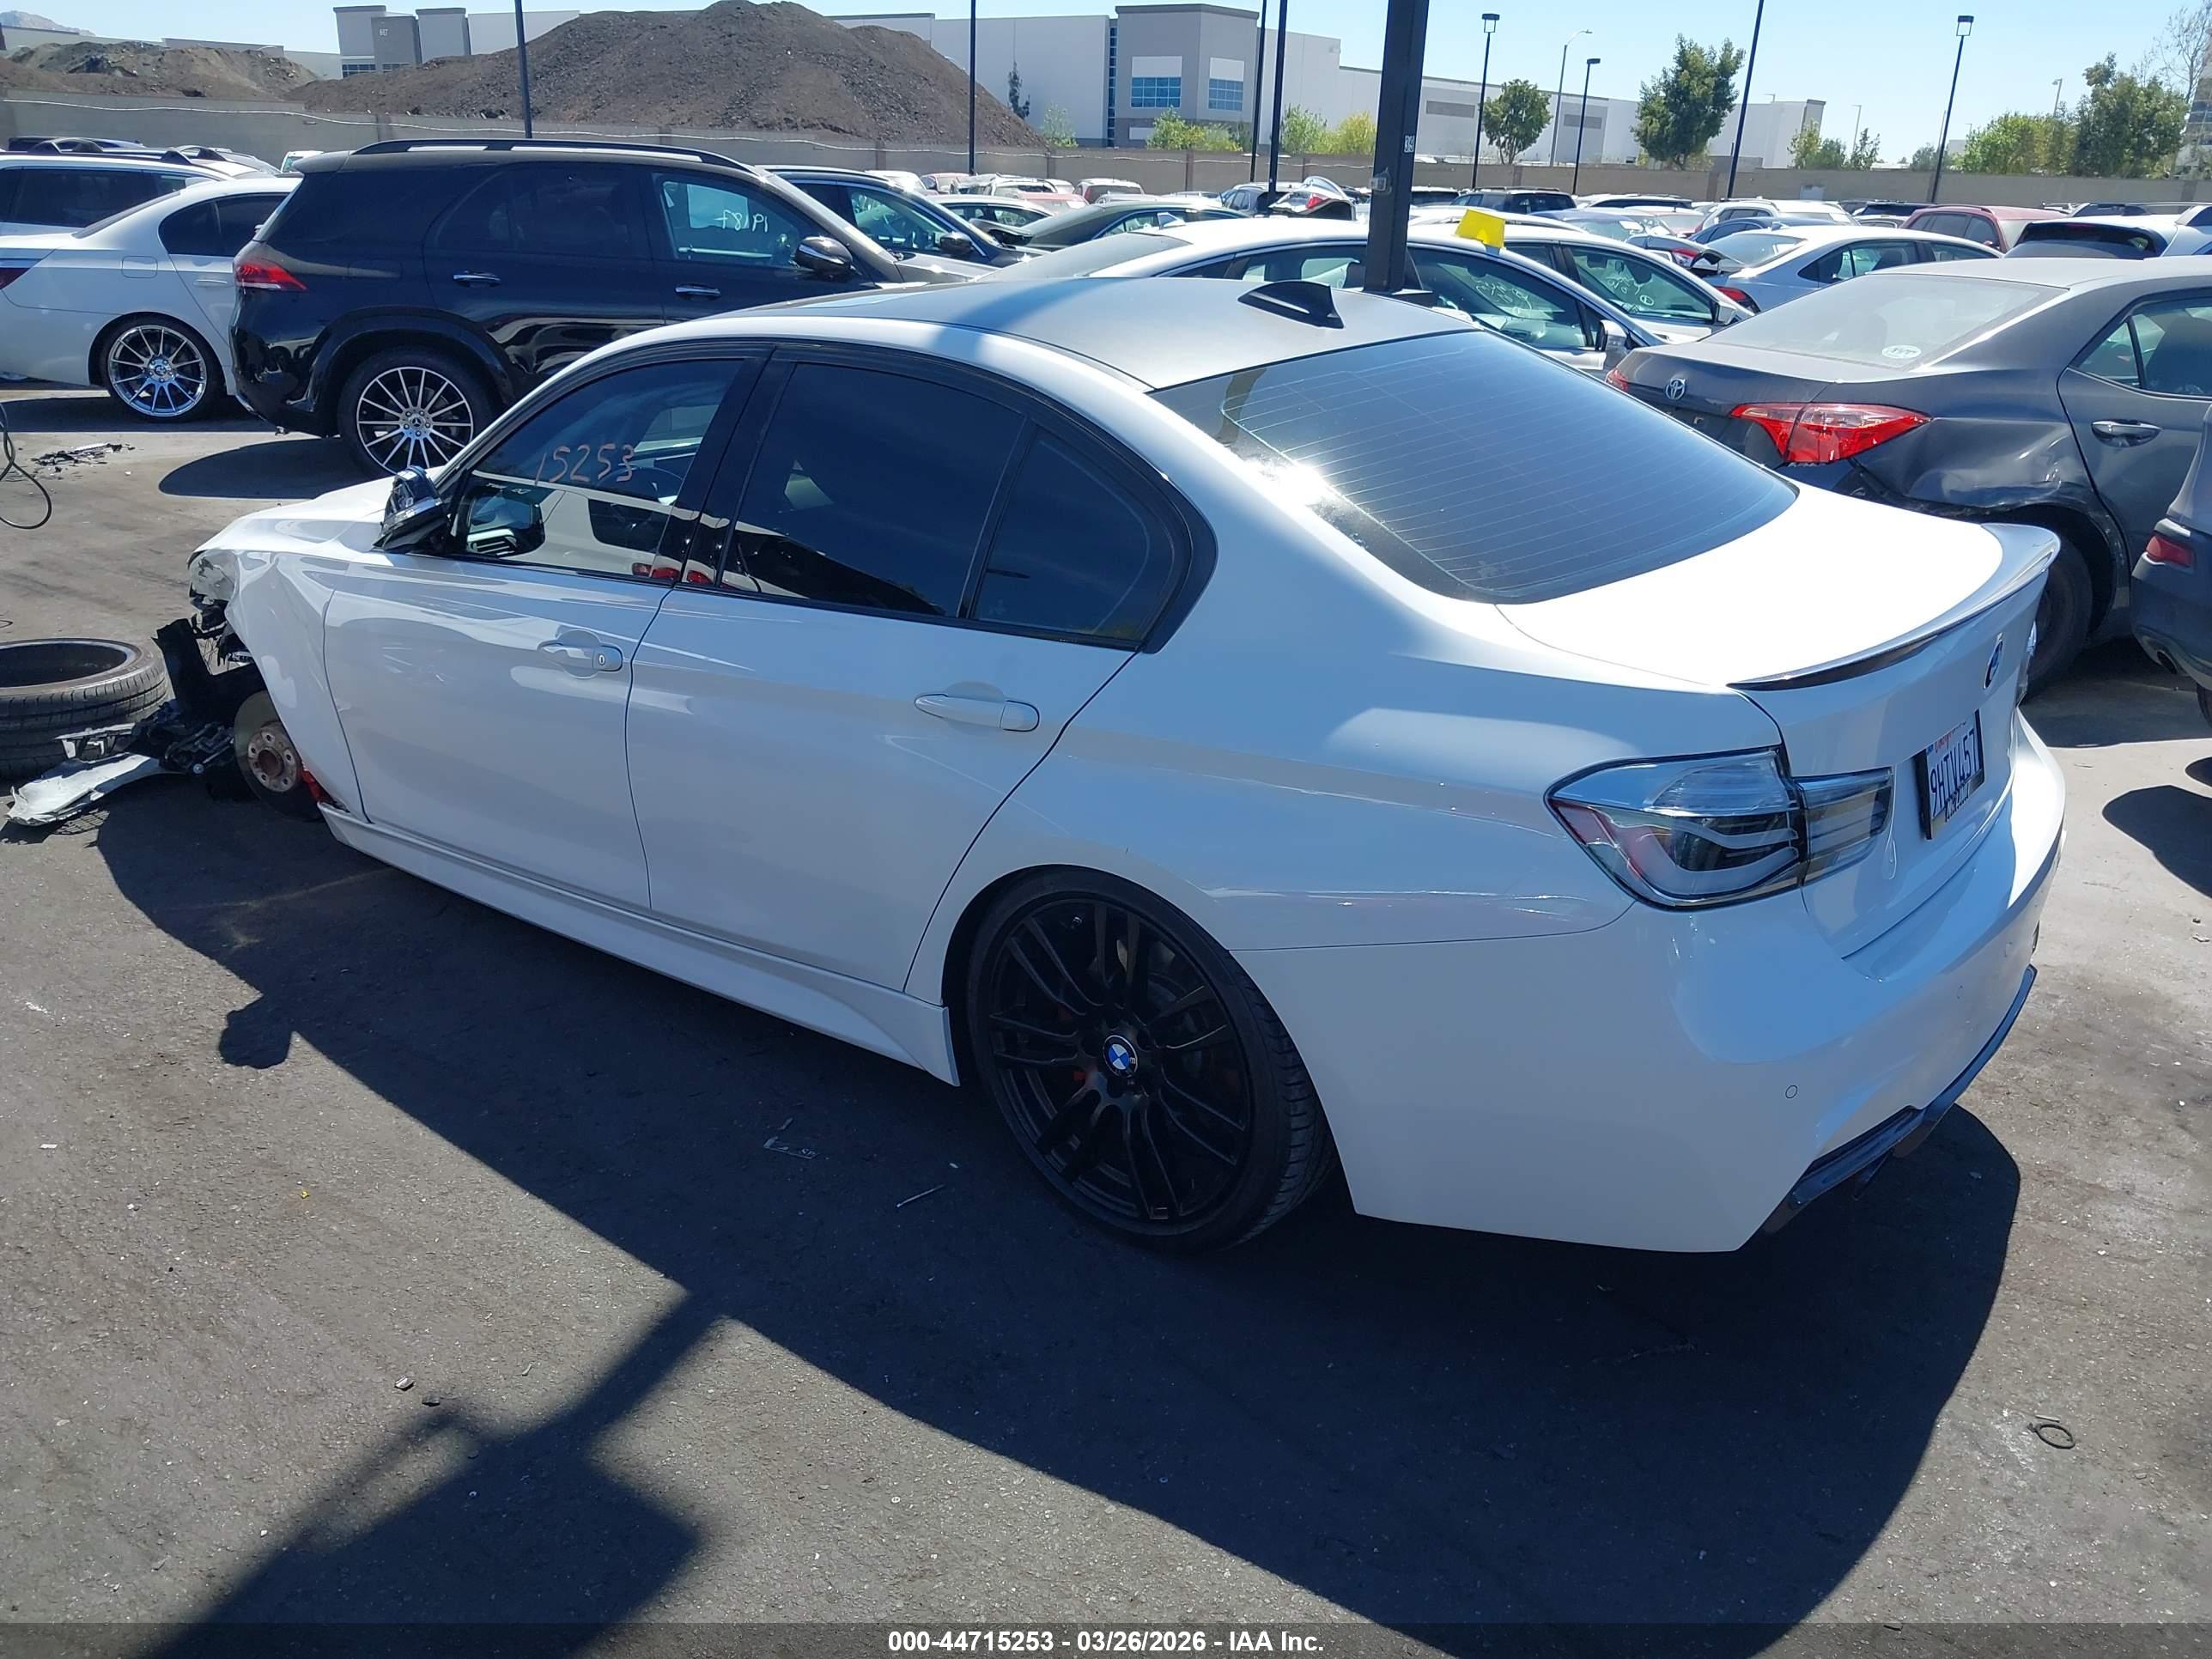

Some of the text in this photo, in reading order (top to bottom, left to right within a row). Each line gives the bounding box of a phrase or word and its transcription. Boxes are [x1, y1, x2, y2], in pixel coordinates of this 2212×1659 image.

[1405, 136, 1414, 152] 39
[534, 443, 634, 484] 15253
[1929, 728, 1978, 817] 9HTV457
